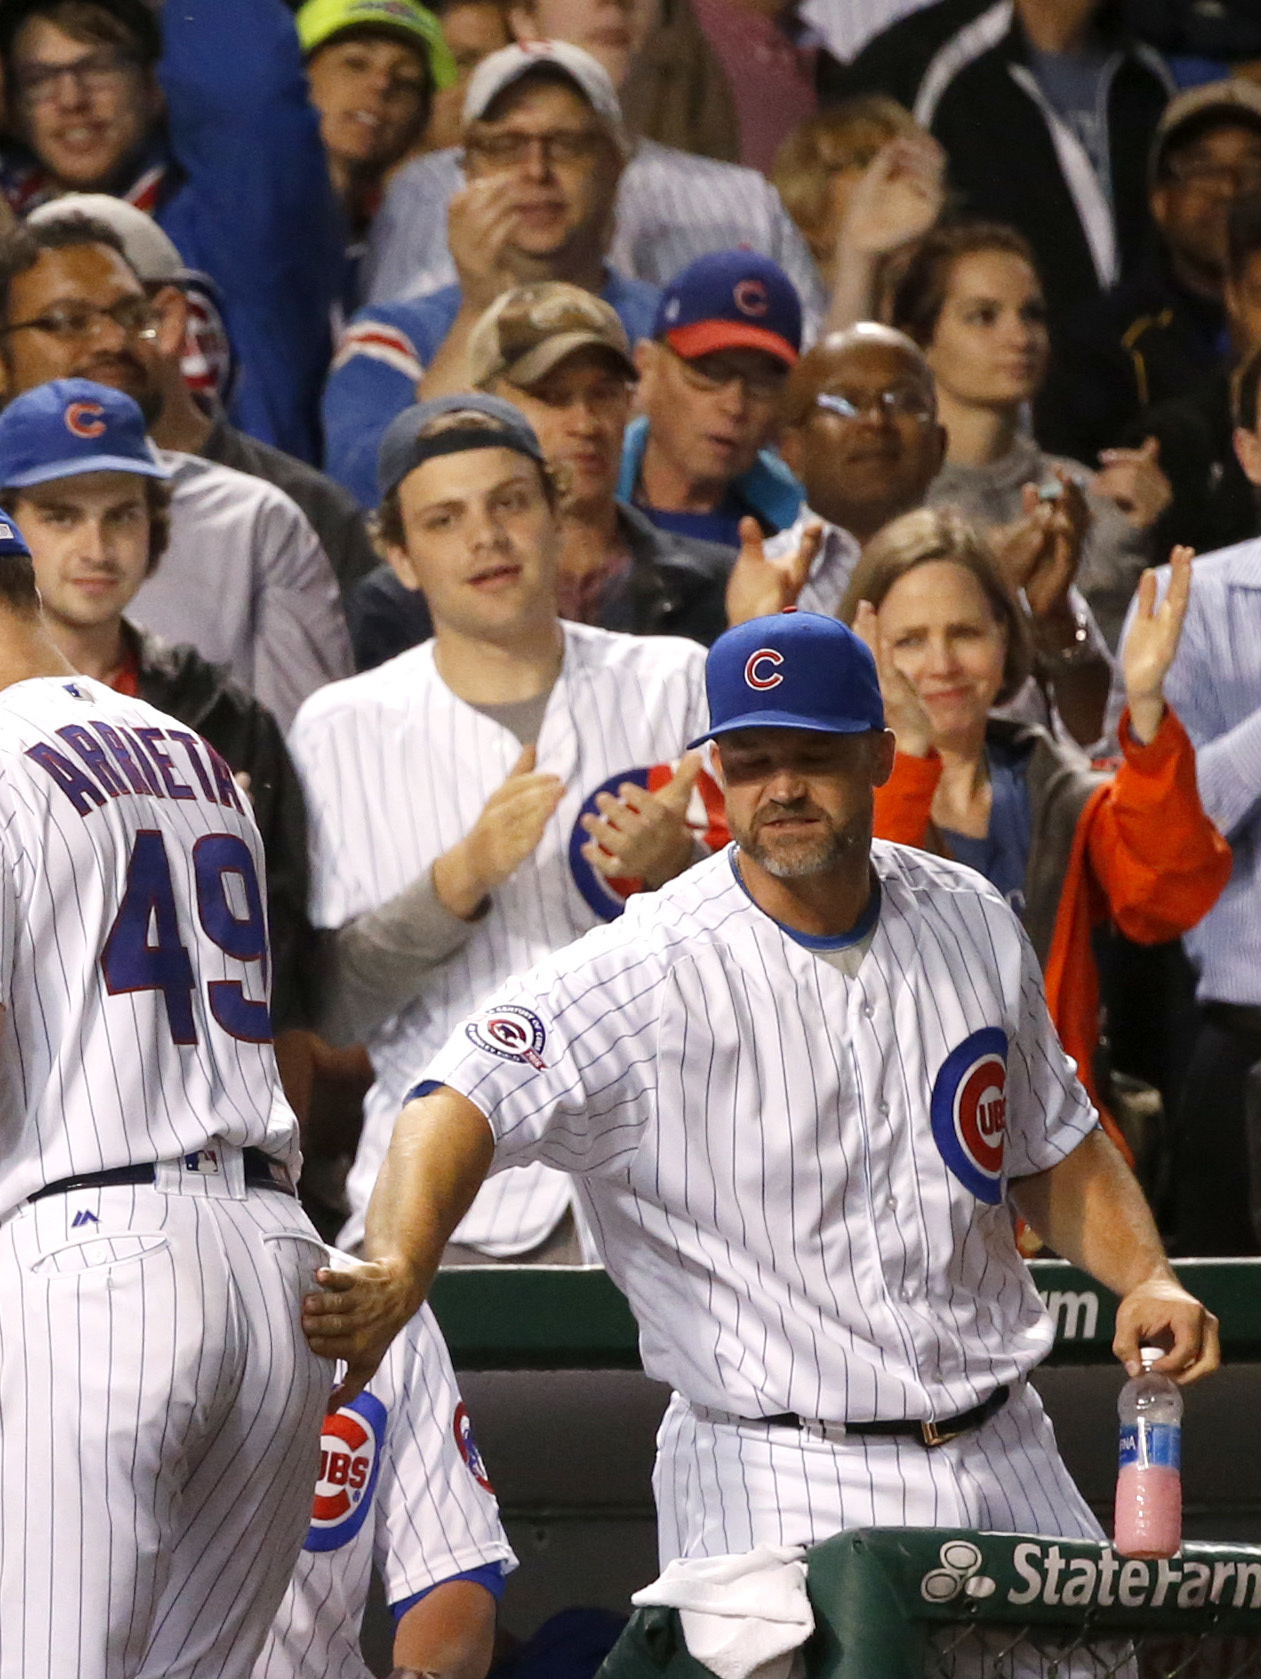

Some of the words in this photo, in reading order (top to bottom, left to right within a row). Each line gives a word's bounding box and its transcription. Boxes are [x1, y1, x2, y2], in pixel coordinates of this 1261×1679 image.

[733, 279, 768, 317] C
[64, 402, 107, 439] C
[744, 648, 784, 691] C
[24, 720, 245, 817] ARRIETA
[100, 829, 274, 1045] 49
